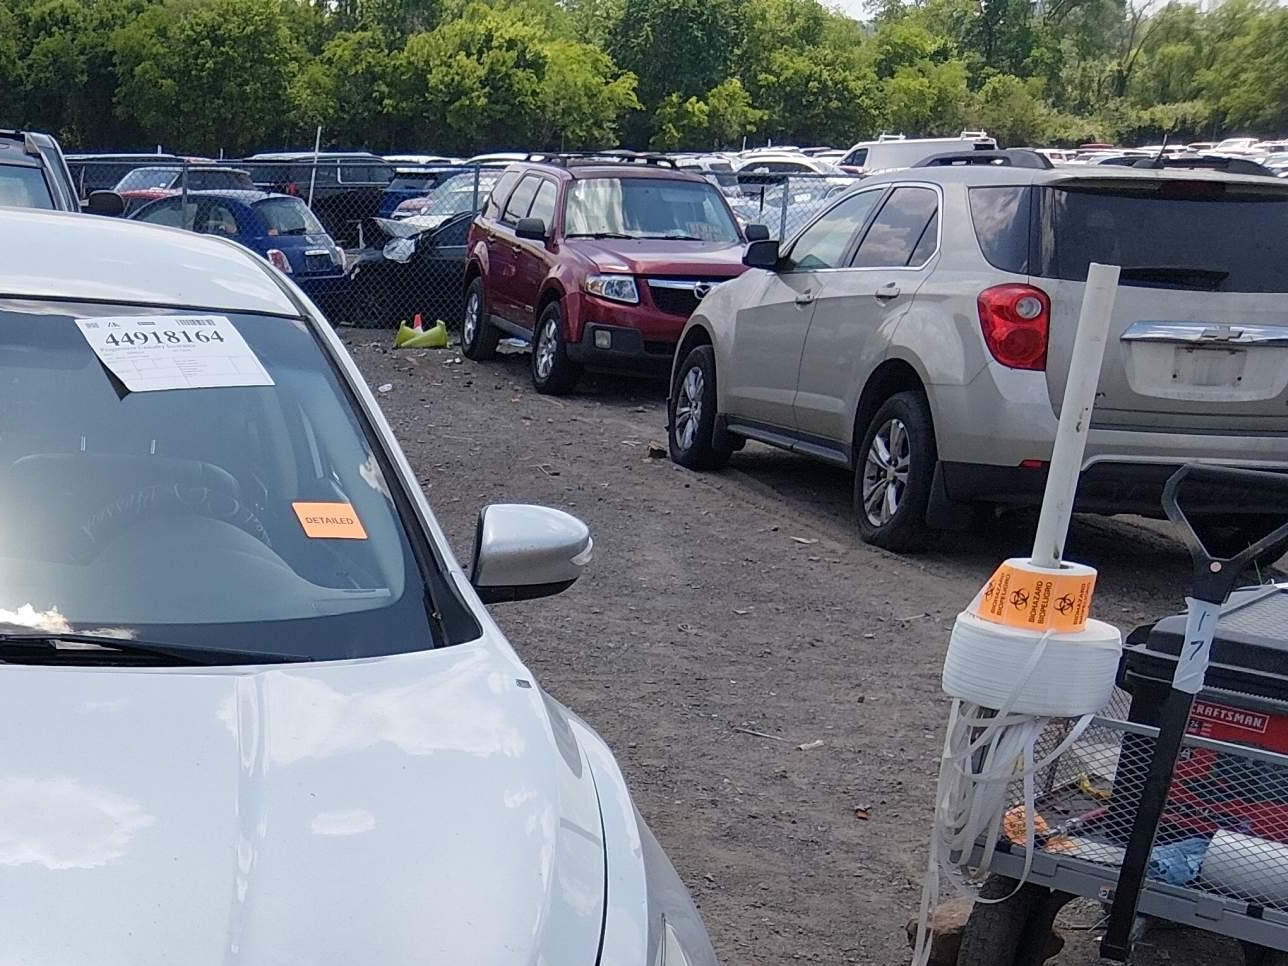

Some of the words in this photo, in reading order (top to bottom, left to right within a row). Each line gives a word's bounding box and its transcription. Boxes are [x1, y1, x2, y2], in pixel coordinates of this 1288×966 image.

[105, 329, 225, 347] 44918164
[305, 517, 354, 525] DETAILED
[1028, 581, 1043, 623] BIOHAZARD
[1038, 582, 1053, 625] BIOPELIGRO
